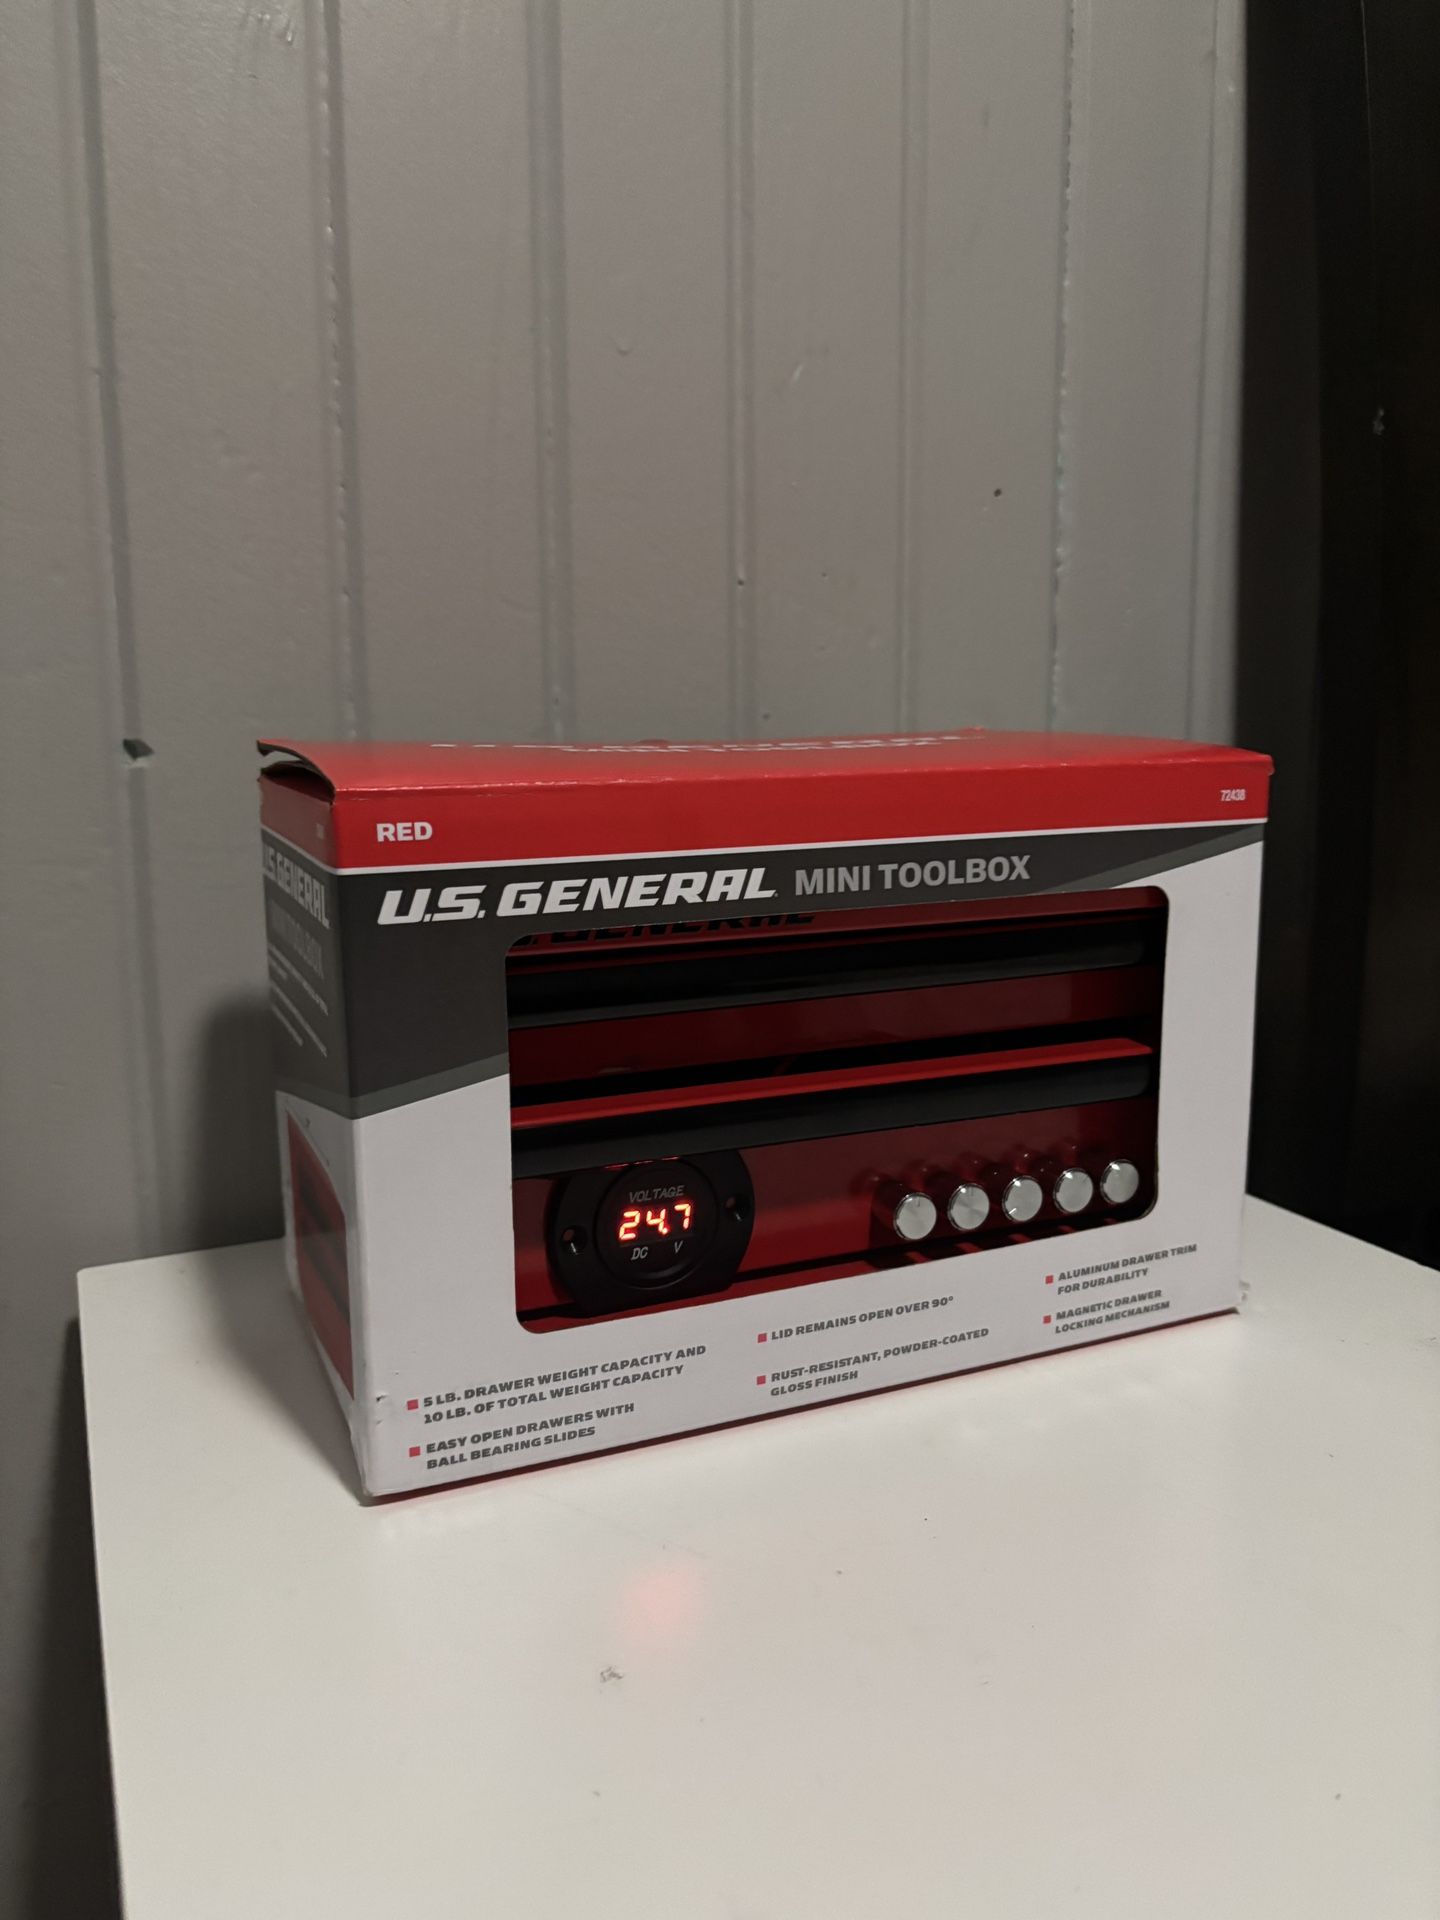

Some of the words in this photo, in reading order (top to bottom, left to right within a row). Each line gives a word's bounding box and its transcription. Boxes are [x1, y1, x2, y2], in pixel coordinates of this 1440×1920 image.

[376, 821, 433, 842] RED
[377, 884, 487, 925] U.S.
[496, 867, 777, 917] GENERAL
[795, 865, 871, 896] MINI
[878, 855, 1031, 889] TOOLBOX
[629, 1185, 685, 1204] VOLTAGE
[631, 1246, 649, 1261] DC
[674, 1240, 684, 1253] V
[1058, 1260, 1120, 1281] ALUMINUM
[1121, 1249, 1169, 1267] DRAWER
[1170, 1244, 1197, 1257] TRIM
[1057, 1283, 1080, 1295] FOR
[1082, 1268, 1148, 1290] DURABILITY
[771, 1328, 793, 1341] LID
[796, 1316, 856, 1336] REMAINS
[859, 1308, 893, 1323] OPEN
[895, 1301, 930, 1316] OVER
[1055, 1316, 1103, 1334] LOCKING
[1105, 1301, 1170, 1323] MECHANISM
[1056, 1300, 1113, 1320] MAGNETIC
[1114, 1290, 1162, 1307] DRAWER
[771, 1352, 881, 1382] RUST-RESISTANT,
[883, 1328, 989, 1359] POWDER-COATED
[423, 1397, 433, 1408] 5
[436, 1392, 461, 1406] LB.
[464, 1377, 534, 1399] DRAWER
[537, 1365, 599, 1386] WEIGHT
[600, 1351, 672, 1373] CAPACITY
[675, 1345, 707, 1359] AND
[424, 1411, 443, 1424] 10
[446, 1407, 472, 1421] LB.
[474, 1401, 496, 1414] OF
[497, 1391, 547, 1410] TOTAL
[549, 1378, 610, 1399] WEIGHT
[612, 1365, 684, 1387] CAPACITY
[771, 1380, 813, 1396] GLOSS
[815, 1370, 858, 1387] FINISH
[426, 1436, 467, 1454] EASY
[470, 1427, 513, 1445] OPEN
[516, 1411, 593, 1435] DRAWERS
[596, 1403, 635, 1419] WITH
[427, 1453, 467, 1469] BALL
[470, 1437, 541, 1460] BEARING
[544, 1427, 596, 1445] SLIDES
